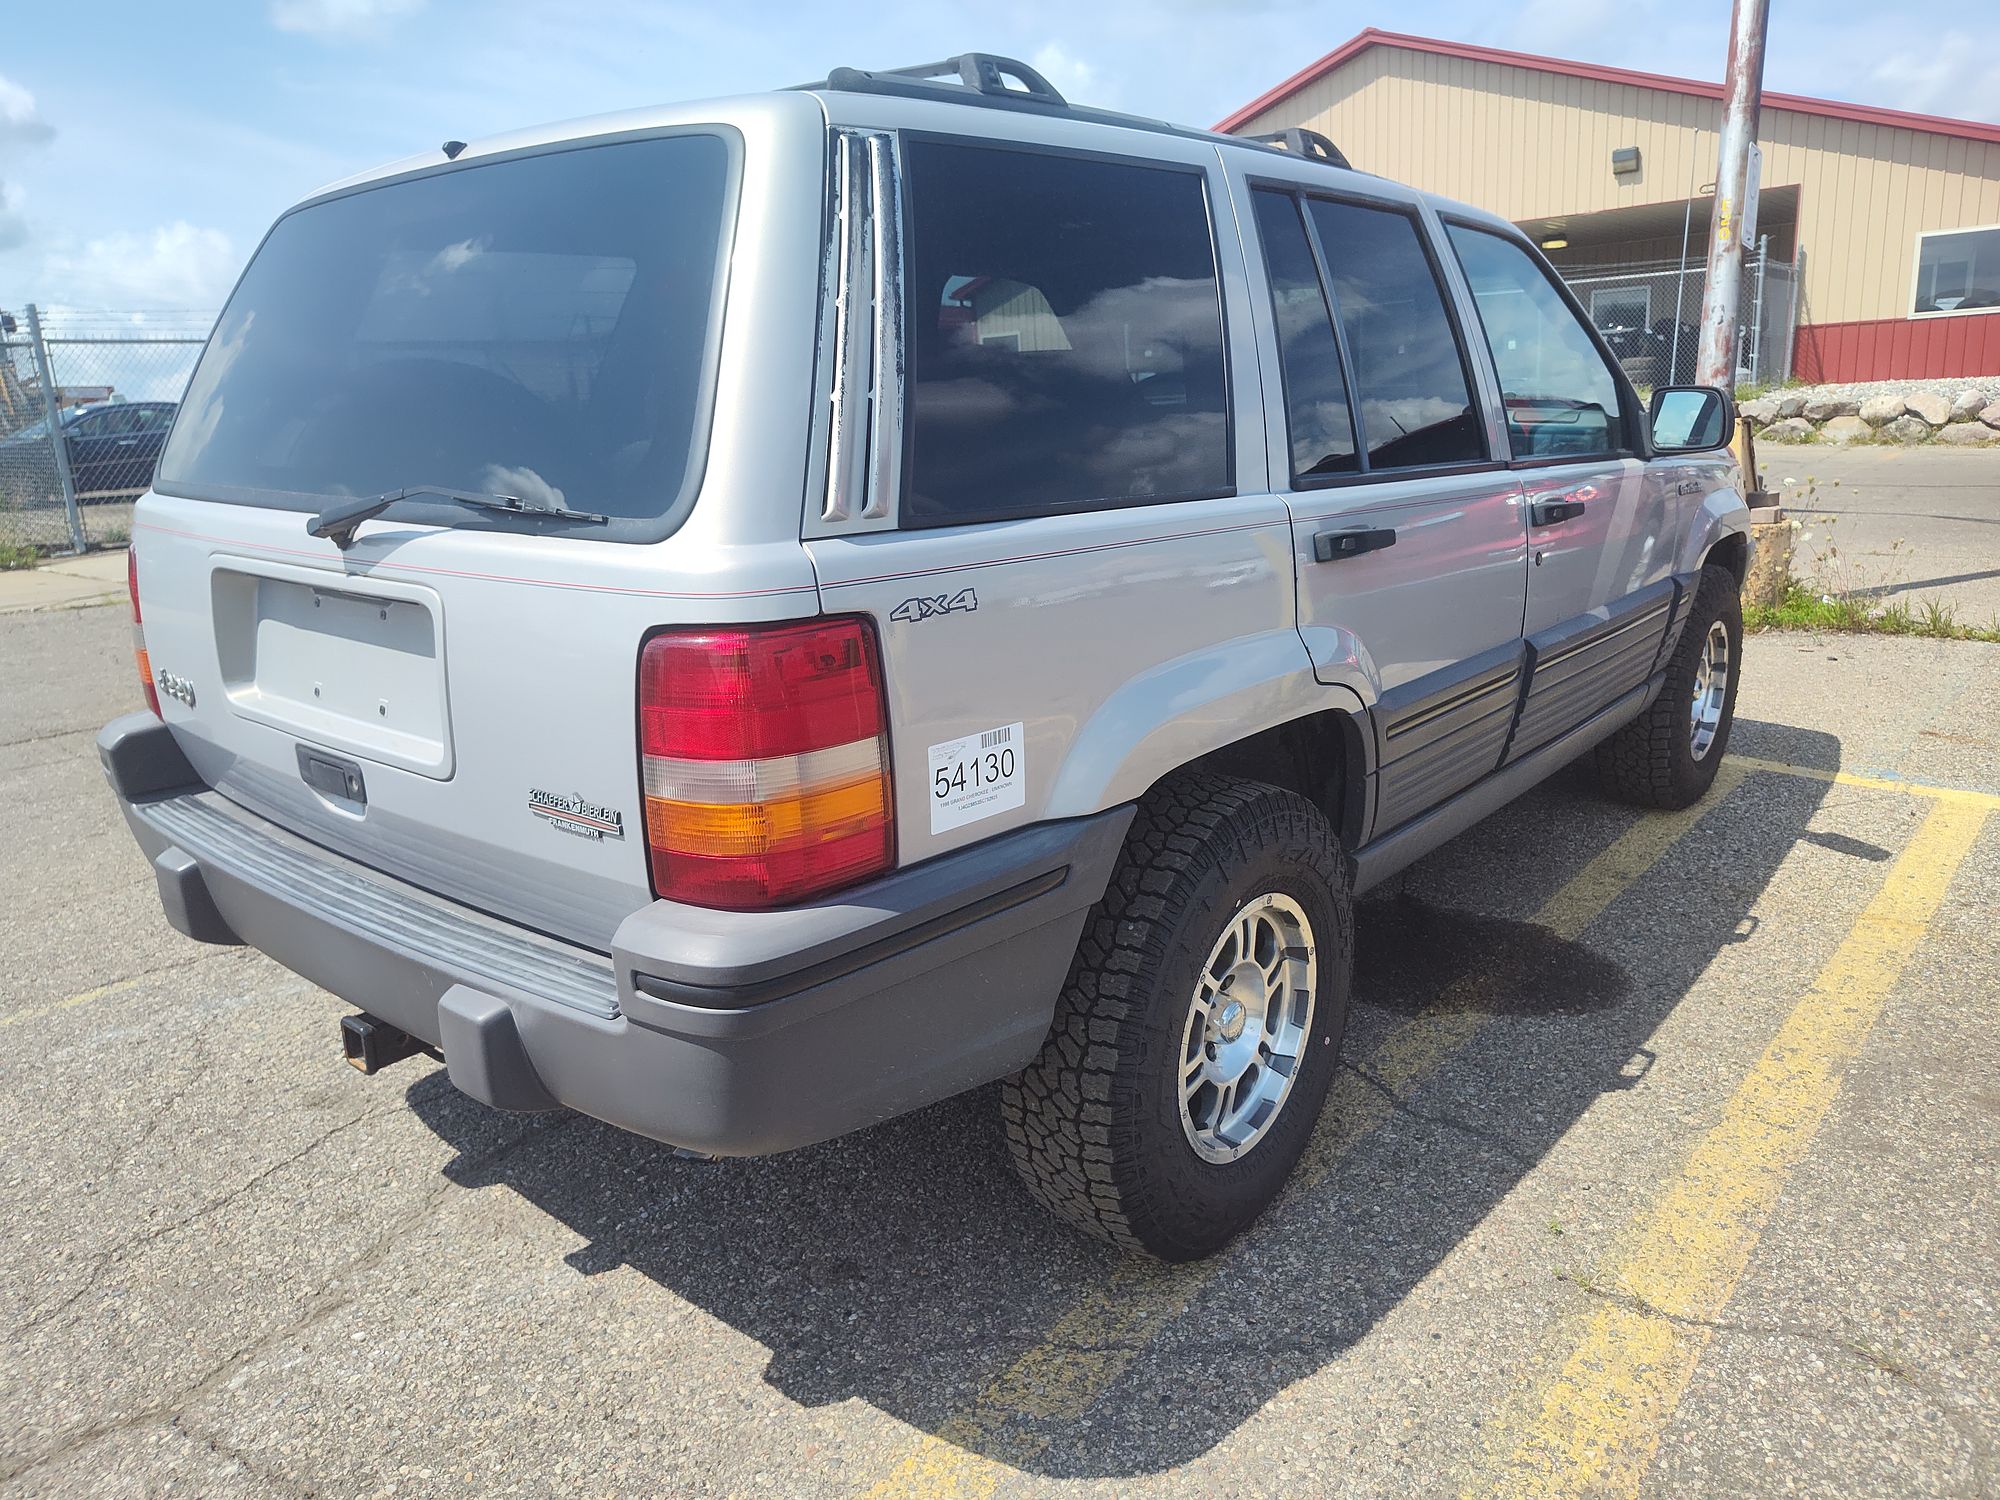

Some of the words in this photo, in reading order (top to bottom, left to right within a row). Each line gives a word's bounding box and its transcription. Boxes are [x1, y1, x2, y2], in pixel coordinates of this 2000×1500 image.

[935, 748, 1015, 799] 54130
[950, 796, 966, 805] GRAND
[549, 817, 603, 839] FRANKENMUTH
